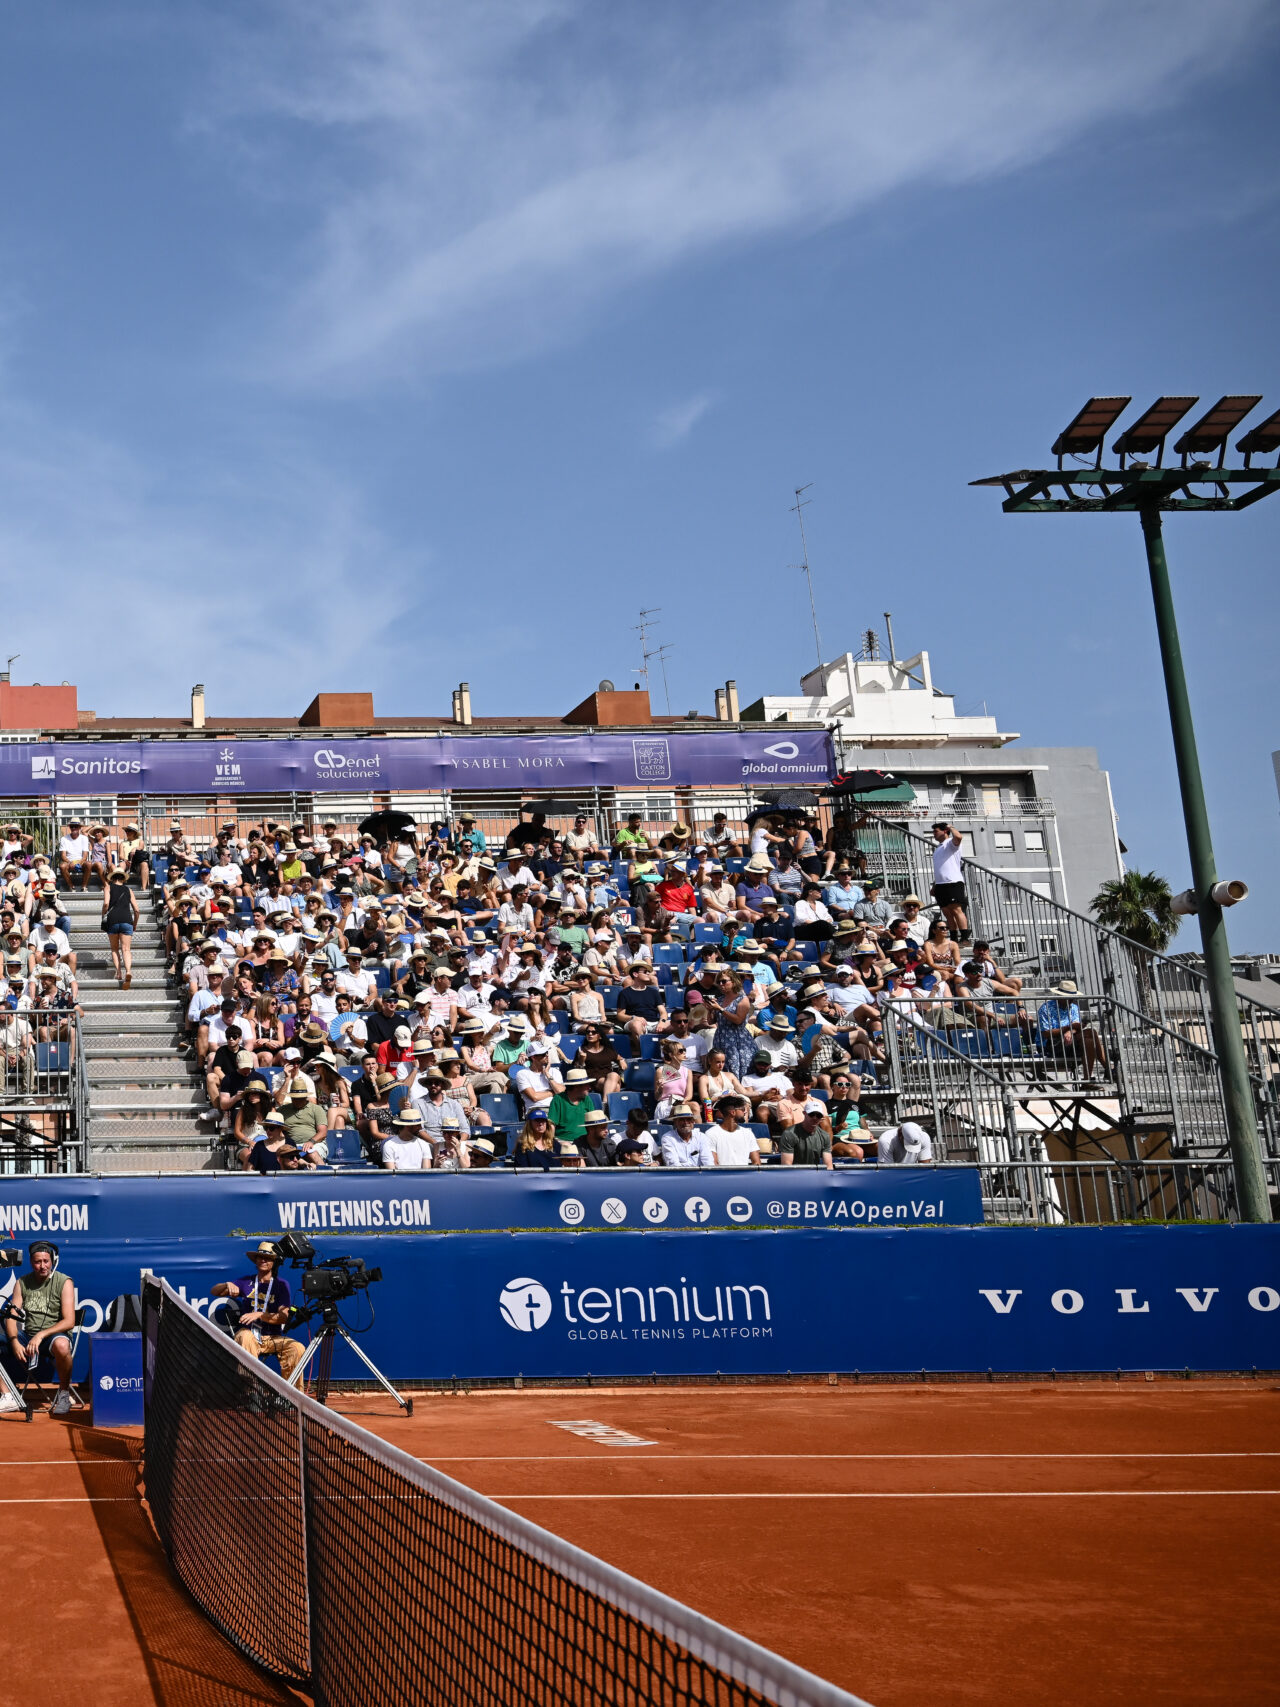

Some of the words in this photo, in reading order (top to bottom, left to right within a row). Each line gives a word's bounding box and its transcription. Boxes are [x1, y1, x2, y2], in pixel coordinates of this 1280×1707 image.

[61, 757, 141, 775] Sanitas
[215, 764, 240, 775] VEM
[452, 758, 510, 769] YSABEL
[518, 757, 565, 768] MORA
[742, 763, 778, 776] global
[780, 763, 828, 773] omnium
[317, 768, 380, 779] soluciones
[278, 1199, 431, 1229] WTATENNIS.COM
[766, 1200, 944, 1222] @BBVAOpenVal
[560, 1276, 771, 1324] tennium
[978, 1286, 1280, 1314] VOLVO
[568, 1329, 628, 1341] GLOBAL
[631, 1328, 686, 1340] TENNIS
[692, 1327, 773, 1339] PLATFORM
